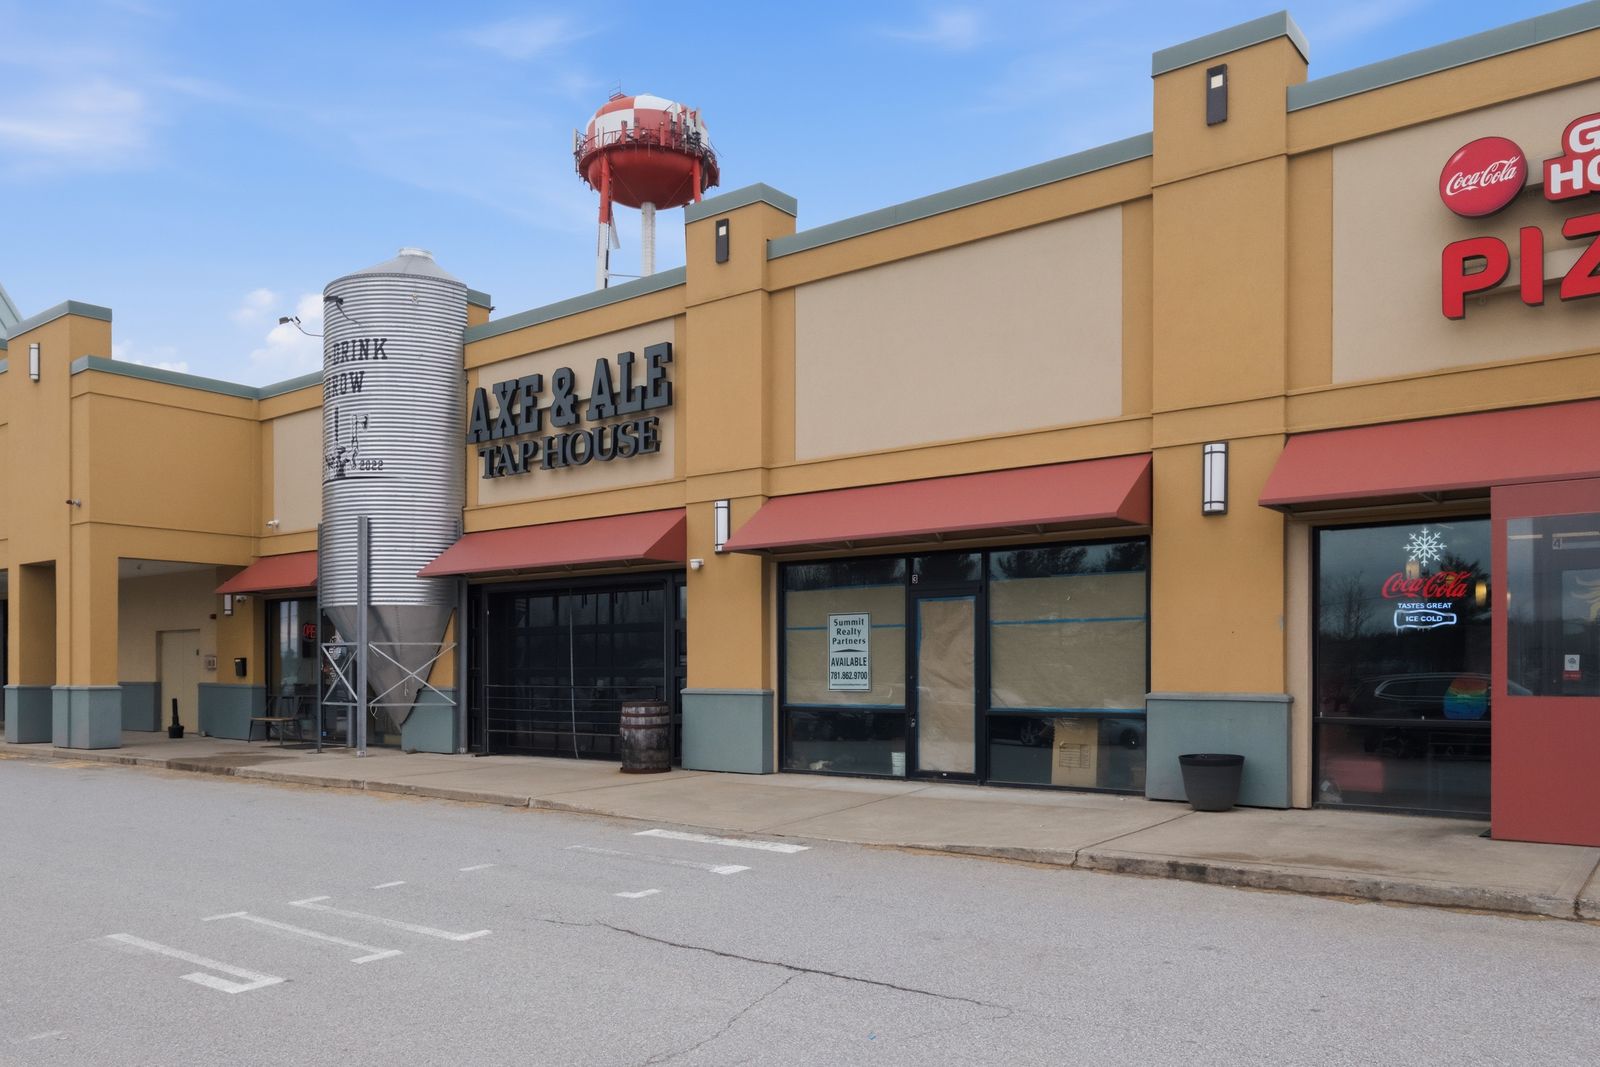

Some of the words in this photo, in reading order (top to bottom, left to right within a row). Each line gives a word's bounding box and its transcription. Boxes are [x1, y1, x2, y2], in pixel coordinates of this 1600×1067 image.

[1445, 155, 1520, 196] Coca-Cola
[467, 373, 543, 444] AXE
[550, 367, 580, 427] &
[586, 341, 673, 421] ALE
[833, 618, 865, 627] Summit
[836, 627, 862, 637] Realty
[832, 637, 866, 645] Partners
[830, 657, 867, 667] AVAILABLE
